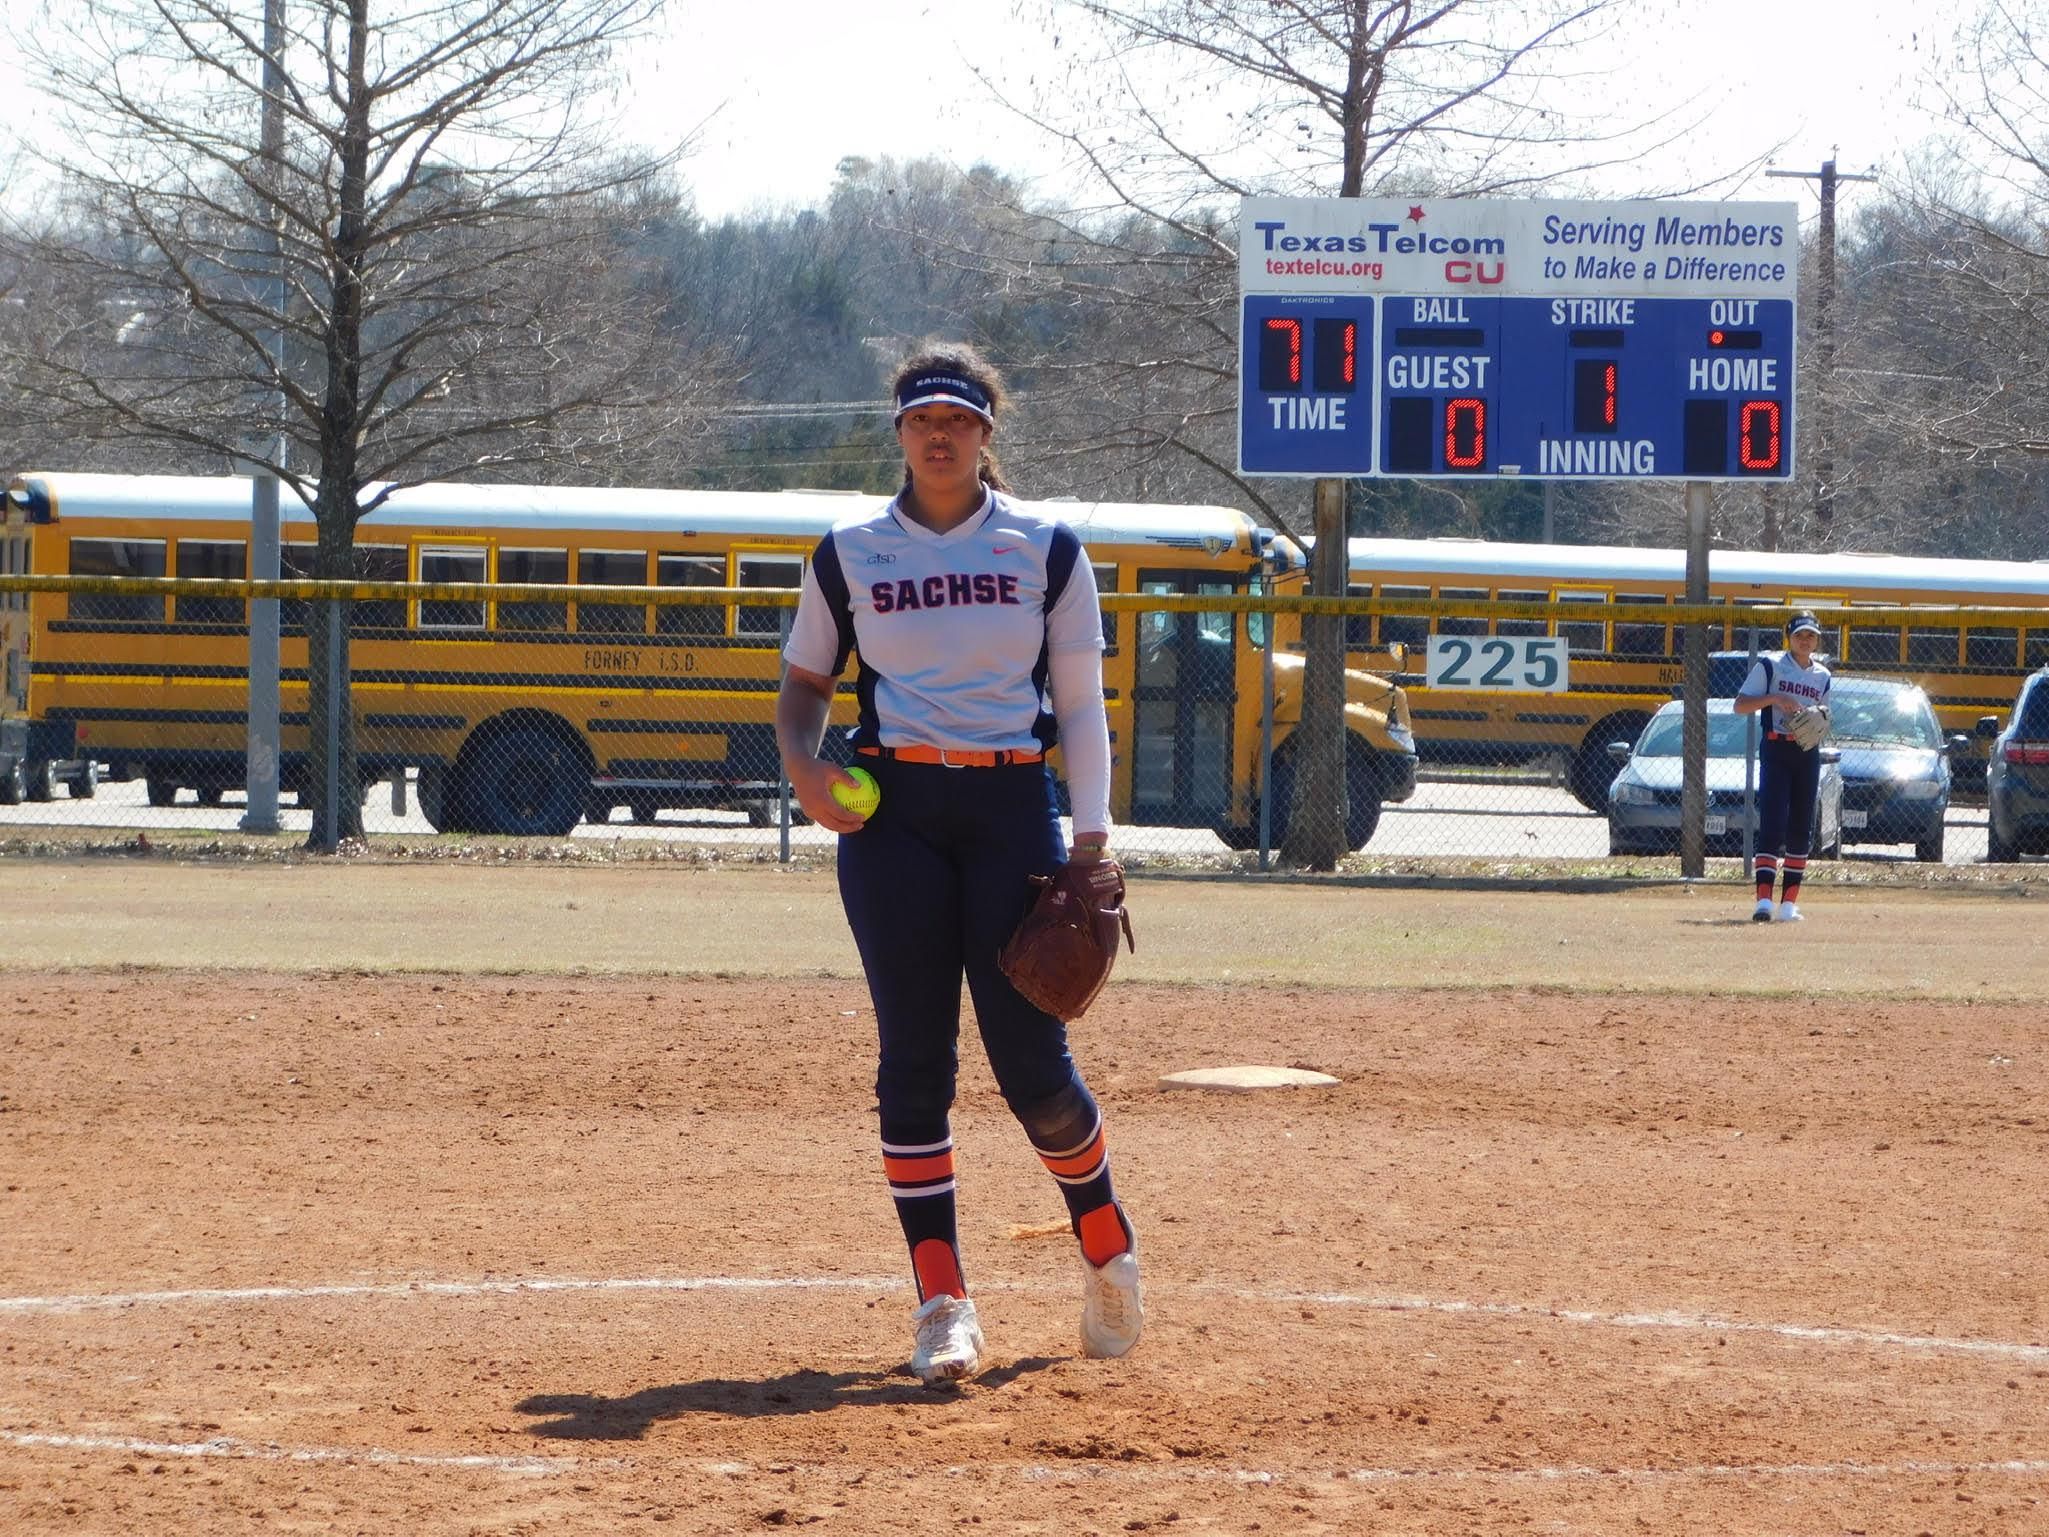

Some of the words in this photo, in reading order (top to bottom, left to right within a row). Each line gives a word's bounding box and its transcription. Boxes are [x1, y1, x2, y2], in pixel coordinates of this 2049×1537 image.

[1543, 214, 1646, 253] Serving
[1655, 216, 1785, 247] Members
[1266, 258, 1383, 280] textelcu.org
[1445, 260, 1505, 284] CU
[1544, 256, 1566, 279] to
[1574, 256, 1637, 280] Make
[1643, 261, 1657, 280] a
[1664, 256, 1786, 281] Difference
[1413, 298, 1470, 323] BALL
[1551, 298, 1636, 325] STRIKE
[1710, 299, 1760, 326] OUT
[916, 376, 969, 390] SACHSE
[1388, 354, 1491, 389] GUEST
[1689, 357, 1777, 392] HOME
[1604, 364, 1616, 425] 1
[1267, 397, 1347, 430] TIME
[1446, 398, 1485, 468] 0
[1741, 400, 1780, 470] 0
[1539, 439, 1656, 475] INNING
[870, 573, 1021, 615] SACHSE
[584, 650, 641, 671] FORNEY
[1436, 638, 1560, 688] 225
[1778, 680, 1821, 701] SACHSE
